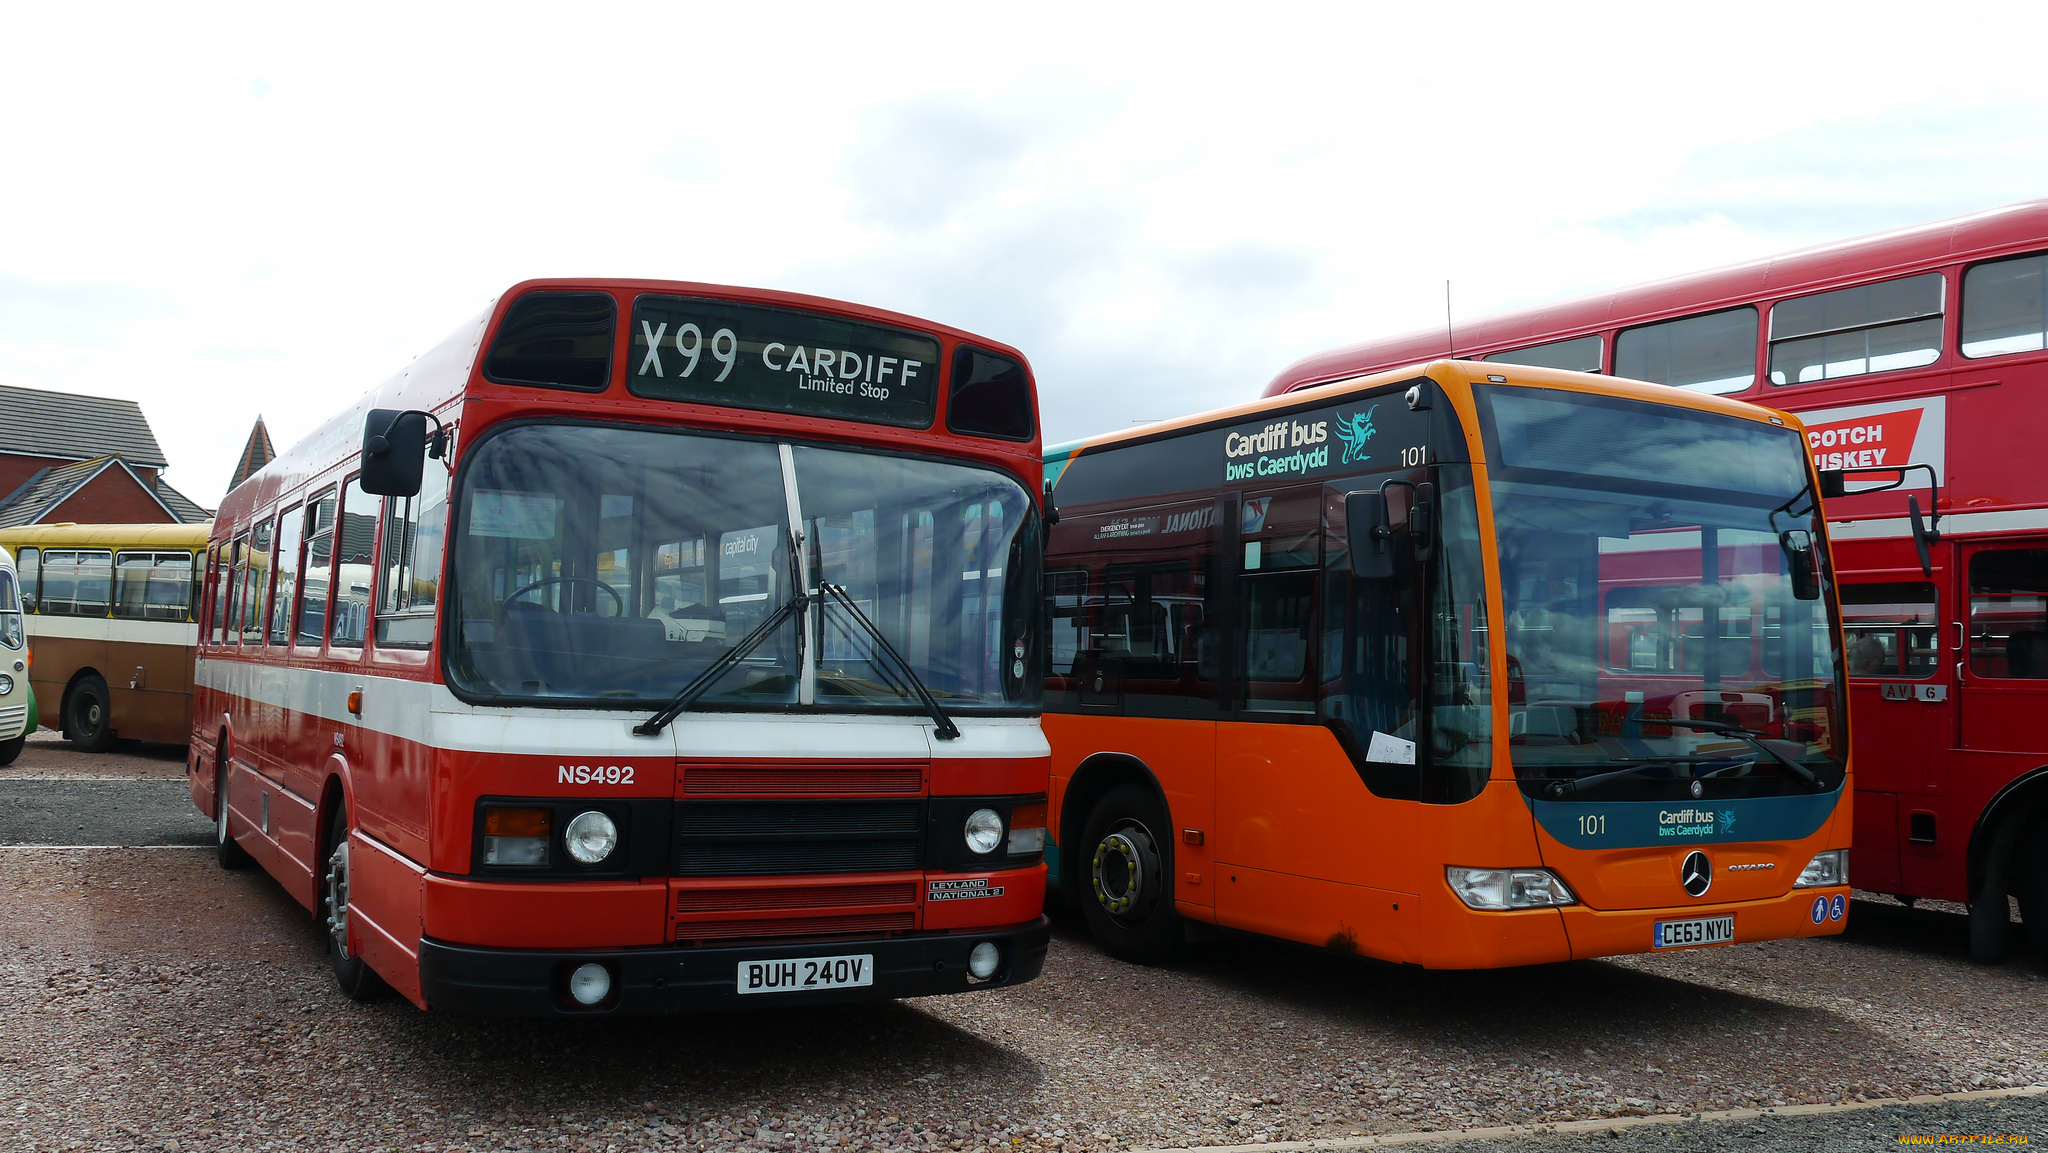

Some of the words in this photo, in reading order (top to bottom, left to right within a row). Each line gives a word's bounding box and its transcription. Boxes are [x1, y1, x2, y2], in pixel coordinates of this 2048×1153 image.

[637, 319, 738, 382] X99
[762, 342, 922, 386] CARDIFF
[799, 374, 854, 395] Limited
[859, 381, 890, 400] Stop
[1225, 422, 1288, 458] Cardiff
[1291, 420, 1328, 447] bus
[1226, 462, 1255, 481] bws
[1257, 445, 1328, 475] Caerdydd
[1400, 445, 1427, 468] 101
[725, 536, 747, 558] capital
[746, 534, 759, 555] city
[1887, 685, 1907, 698] AV
[1926, 687, 1936, 699] 6
[558, 765, 634, 784] NS492
[1578, 815, 1606, 836] 101
[1659, 809, 1695, 825] Cardiff
[1695, 808, 1714, 823] bus
[1659, 825, 1676, 836] bws
[1676, 824, 1714, 836] Caerdydd
[1728, 862, 1775, 872] CITARO
[932, 880, 985, 890] LEYLAND
[933, 890, 991, 900] NATIONAL
[1664, 922, 1702, 944] CE63
[1706, 919, 1732, 940] NYU
[749, 963, 796, 988] BUH
[804, 959, 863, 985] 240V
